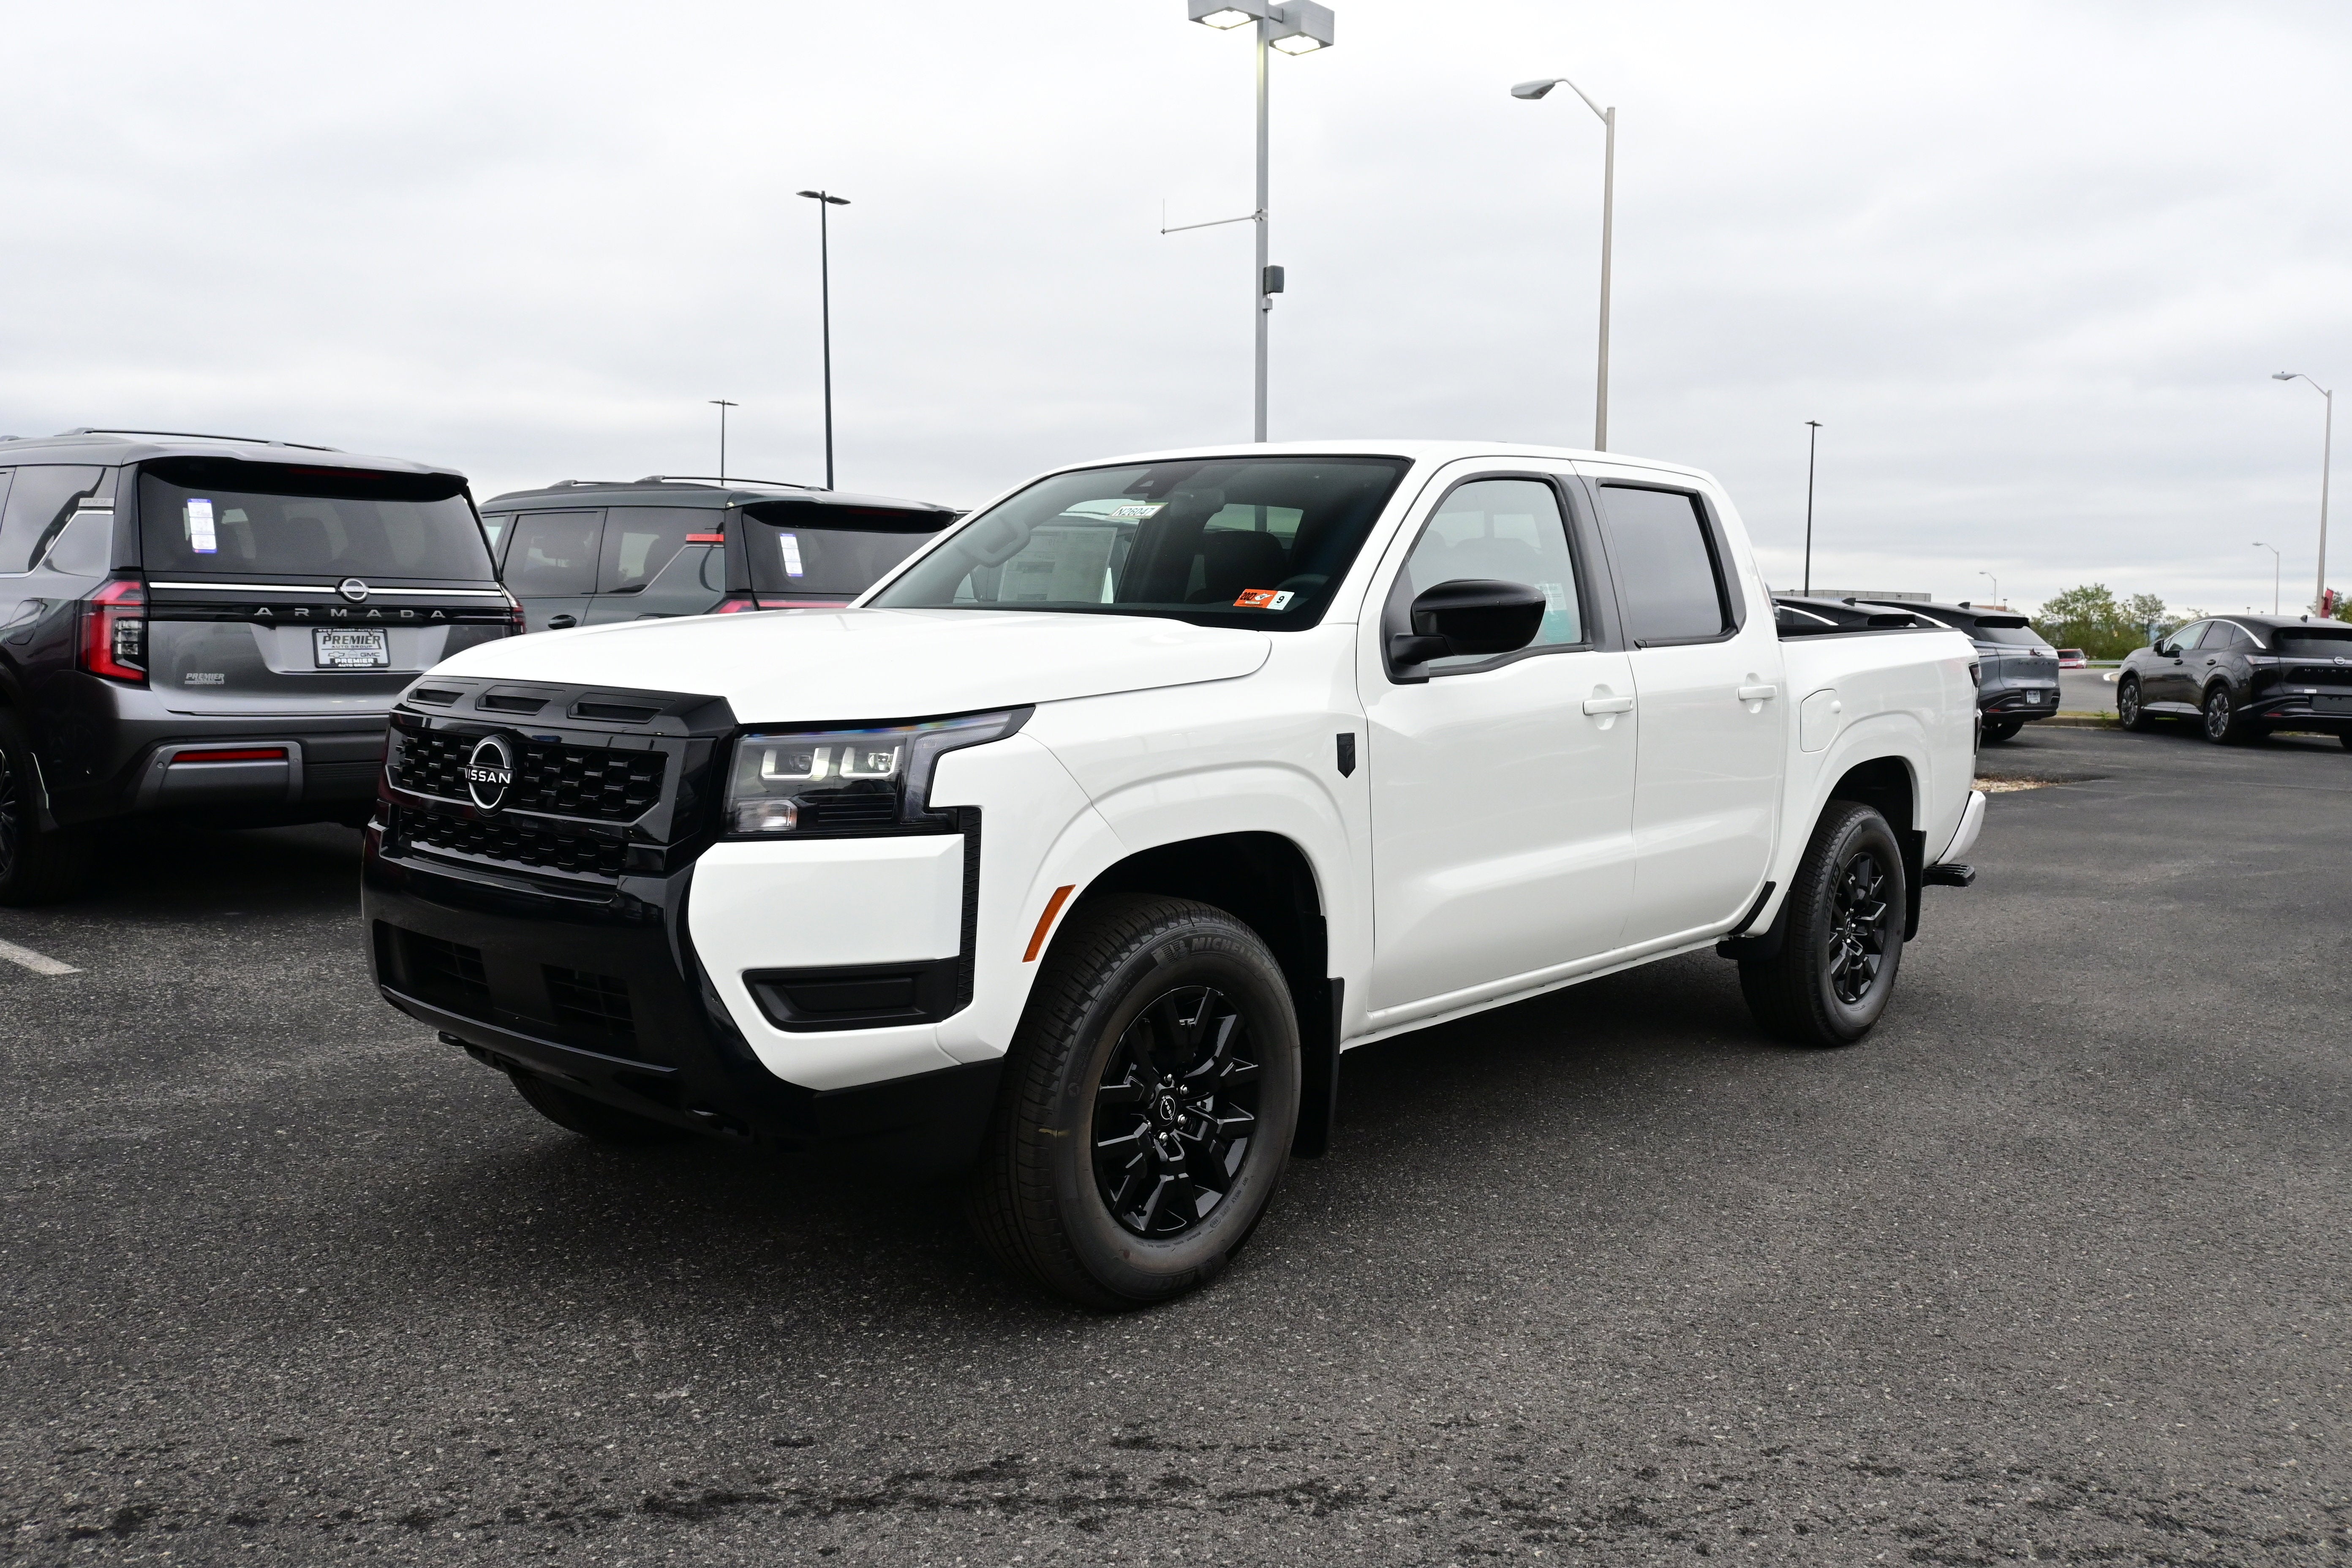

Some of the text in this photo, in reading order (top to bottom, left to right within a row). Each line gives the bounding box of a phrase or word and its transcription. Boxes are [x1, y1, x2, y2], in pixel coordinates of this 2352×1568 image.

[1115, 508, 1154, 516] N26047
[1239, 591, 1258, 601] 2027
[1276, 596, 1285, 604] 9
[254, 607, 446, 618] ARMADA
[322, 635, 382, 649] PREMIER
[185, 673, 225, 681] PREMIER
[465, 768, 511, 784] NISSAN
[1162, 1095, 1173, 1121] NISSAN
